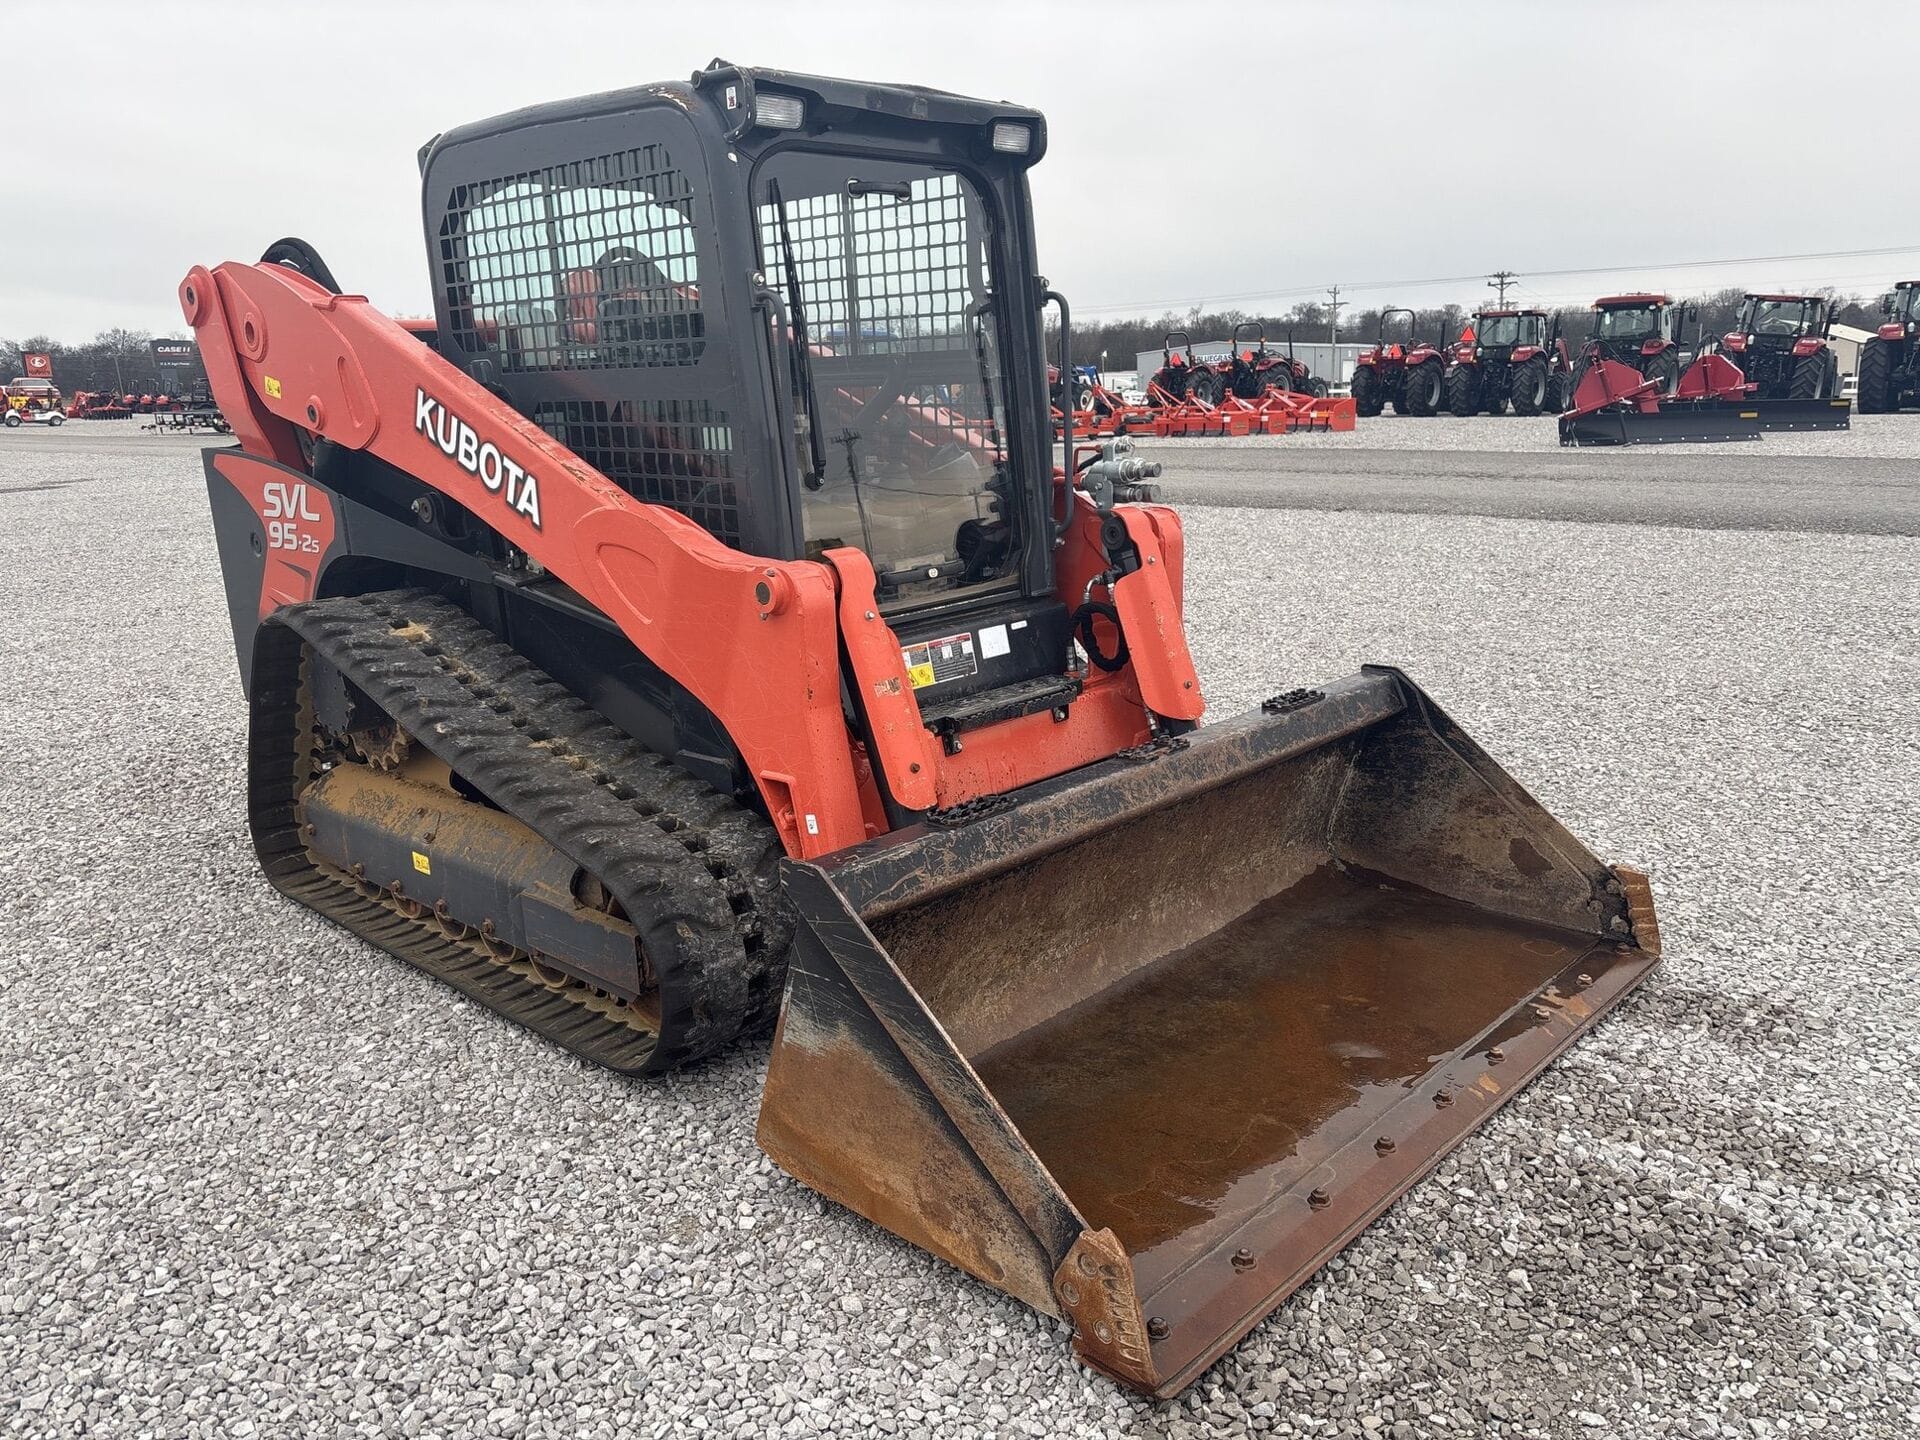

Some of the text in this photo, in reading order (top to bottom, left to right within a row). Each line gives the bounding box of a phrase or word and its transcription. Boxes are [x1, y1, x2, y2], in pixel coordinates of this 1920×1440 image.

[1196, 354, 1233, 363] BLUEGRAS
[415, 387, 541, 526] KUBOTA
[263, 482, 321, 522] SVL
